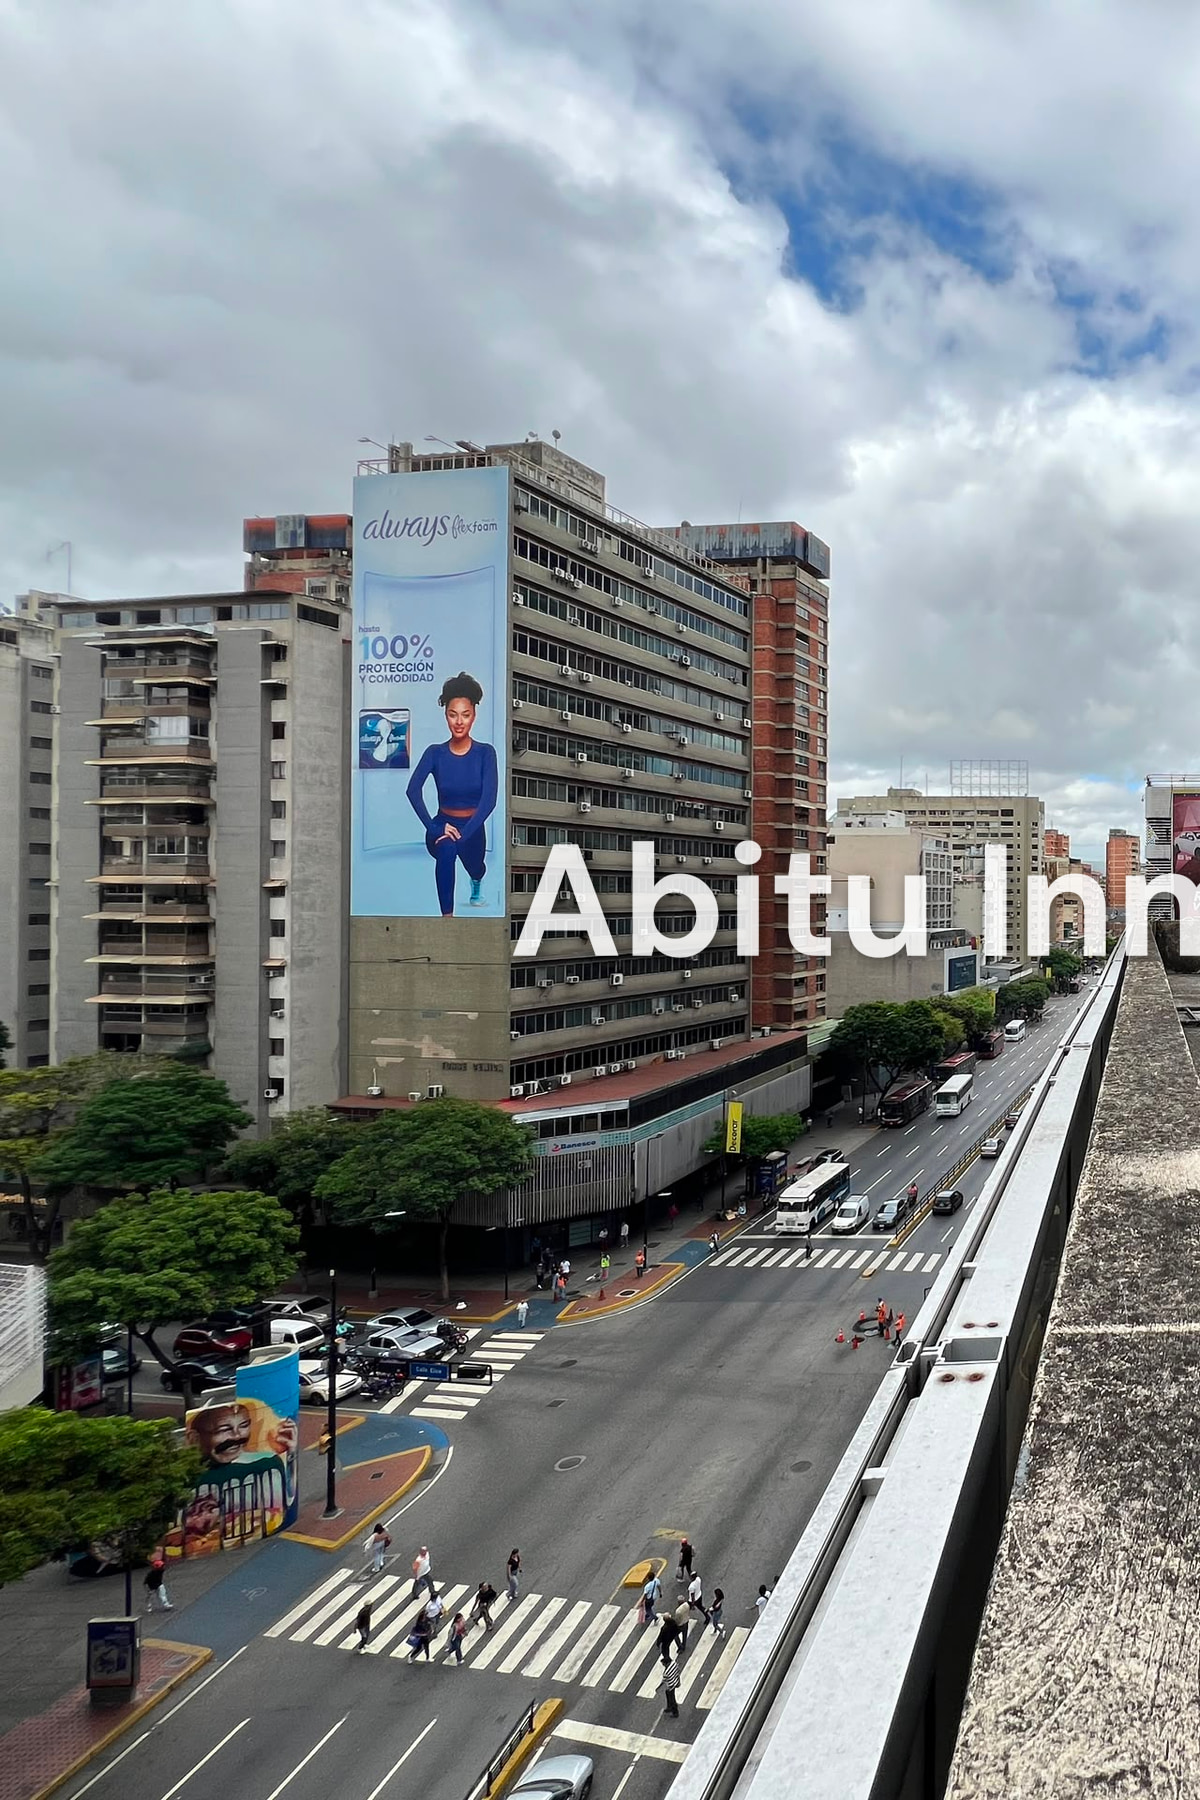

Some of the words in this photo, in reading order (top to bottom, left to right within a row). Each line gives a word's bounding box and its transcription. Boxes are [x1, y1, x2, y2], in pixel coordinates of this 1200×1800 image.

[363, 510, 450, 546] always
[359, 634, 434, 659] 100%
[359, 660, 434, 673] PROTECCIÓN
[359, 675, 366, 683] Y
[369, 674, 434, 683] COMODIDAD
[560, 1140, 596, 1149] Banesco
[729, 1120, 738, 1151] Decorar
